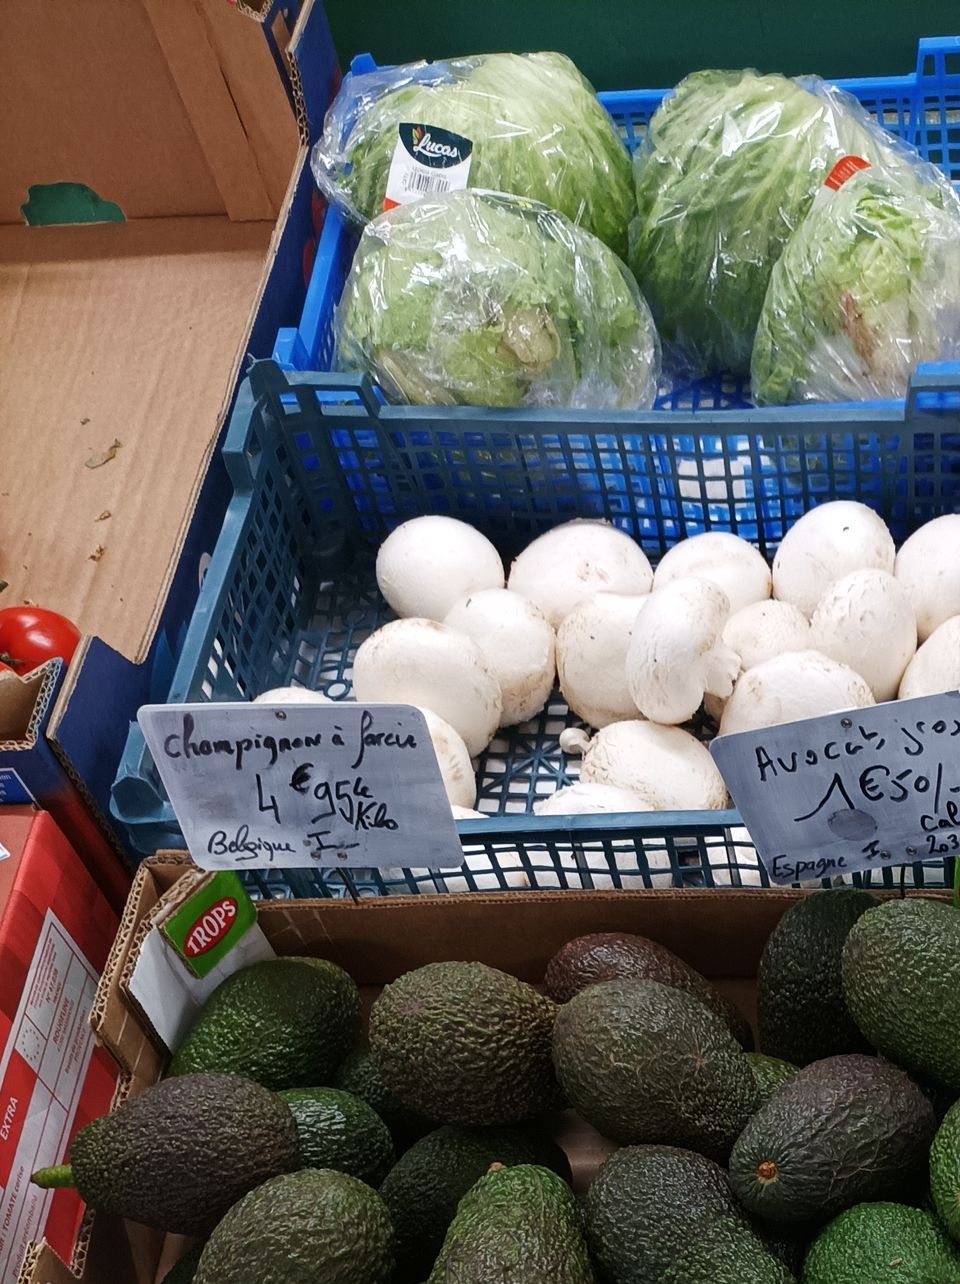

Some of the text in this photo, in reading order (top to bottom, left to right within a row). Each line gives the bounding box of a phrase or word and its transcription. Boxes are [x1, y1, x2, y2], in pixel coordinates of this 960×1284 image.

[413, 133, 458, 157] Lucas
[331, 725, 346, 746] à
[354, 800, 399, 831] Kilo
[207, 824, 296, 862] Belgique
[772, 854, 848, 878] Espagne
[187, 900, 236, 954] TROPS
[0, 1097, 18, 1141] EXTRA
[2, 1191, 16, 1232] TOMATE
